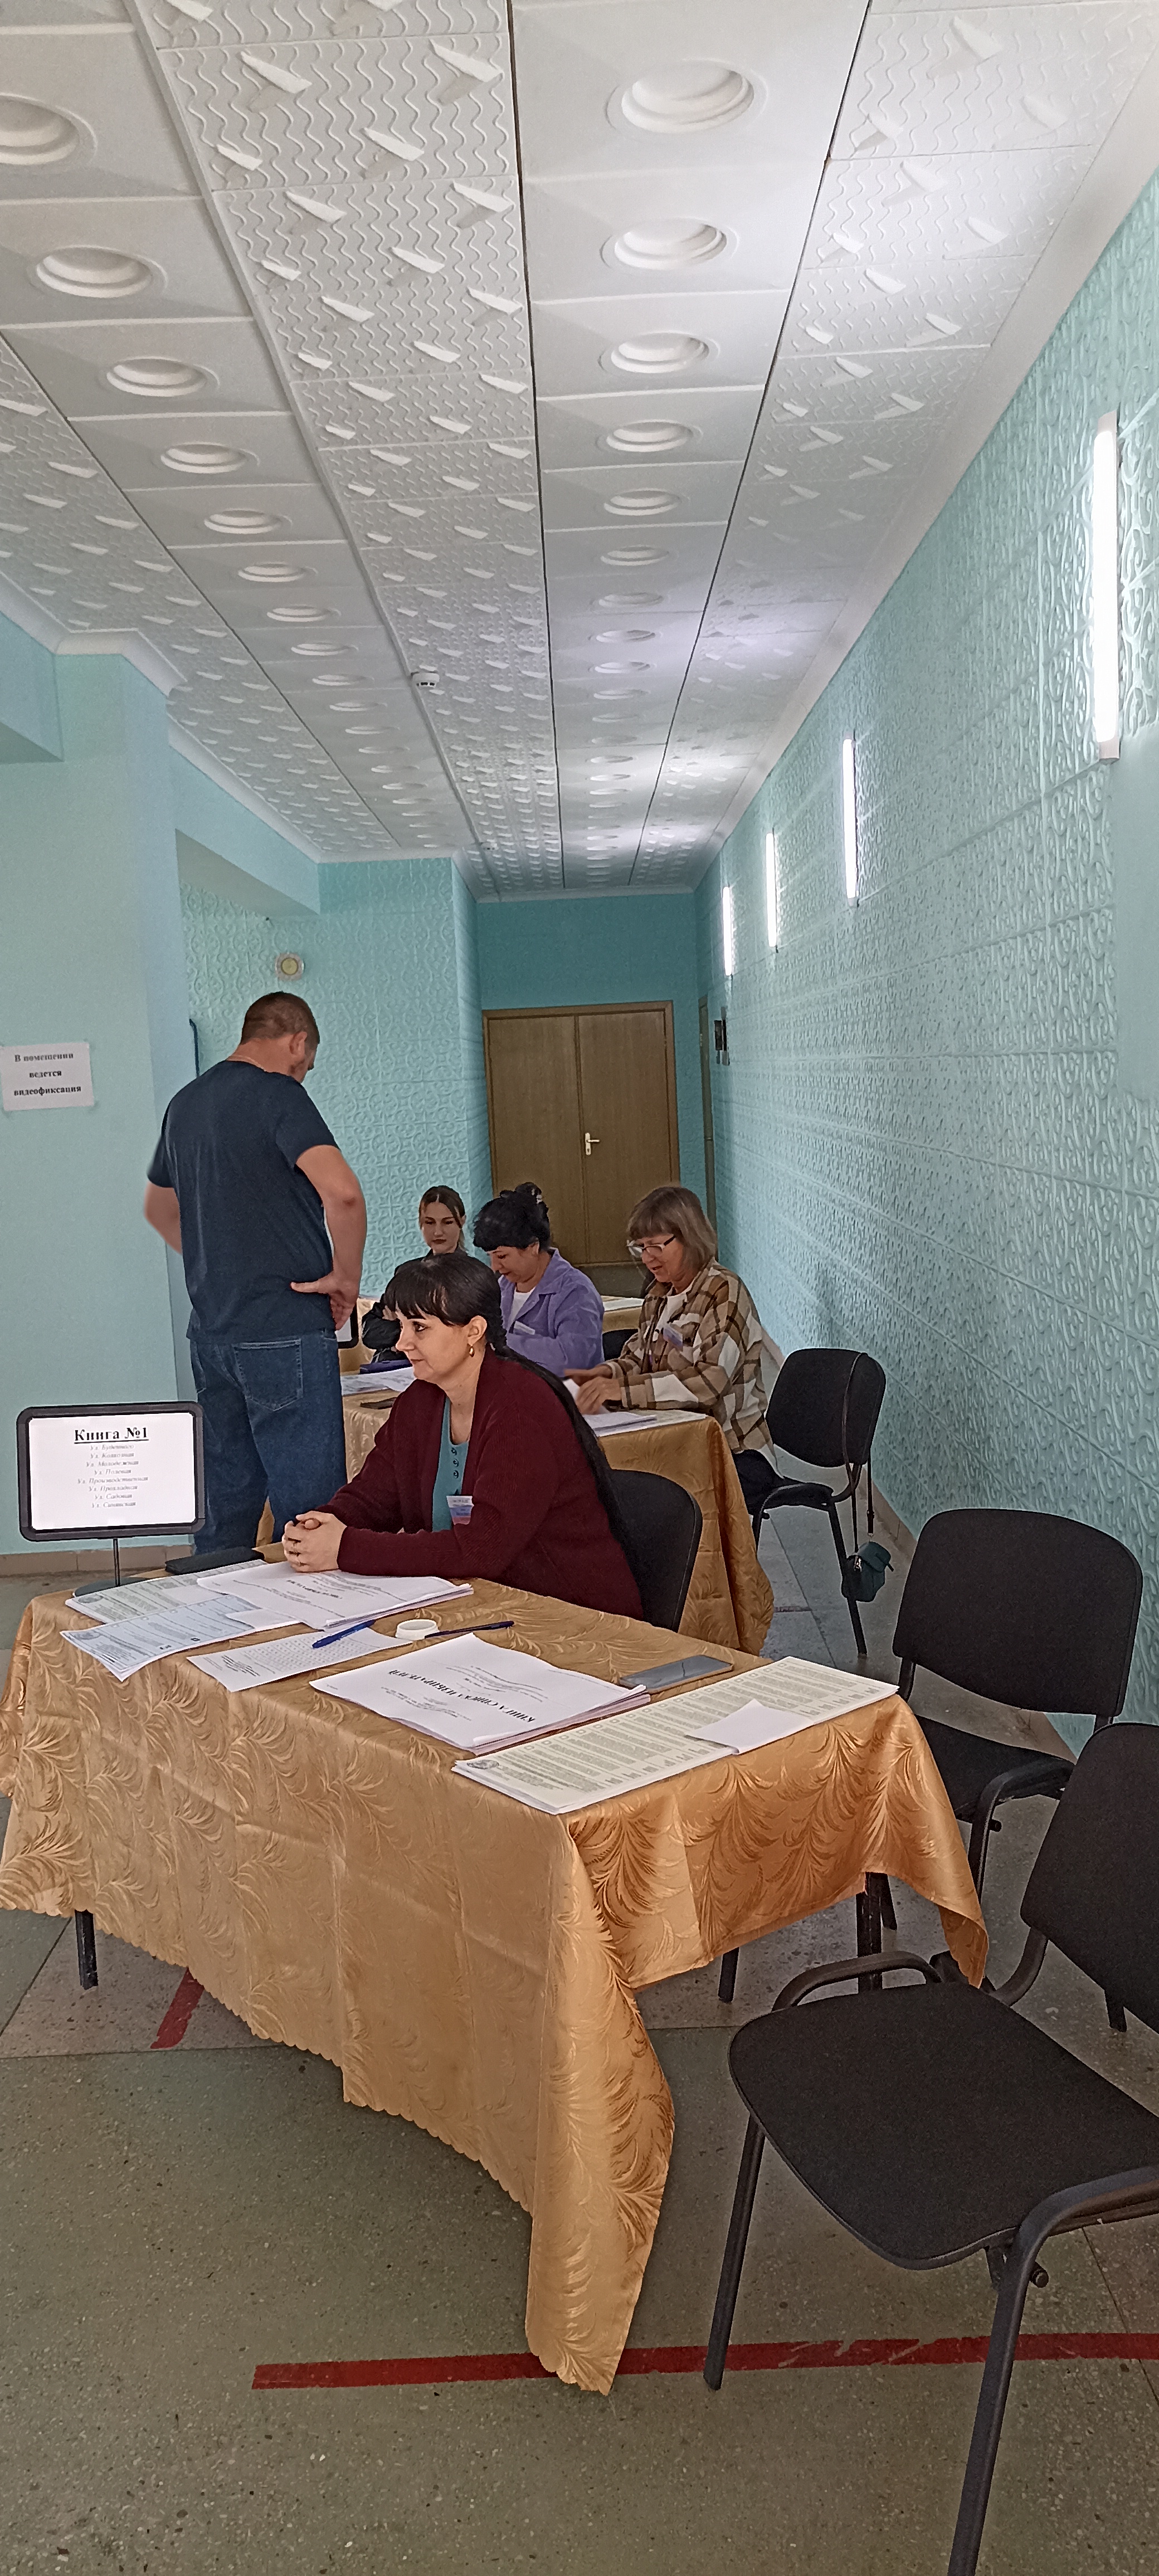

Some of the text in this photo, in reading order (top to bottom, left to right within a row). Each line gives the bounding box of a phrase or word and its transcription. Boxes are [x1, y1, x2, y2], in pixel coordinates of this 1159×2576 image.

[23, 1052, 74, 1062] помещении
[14, 1086, 81, 1096] видеофиксация
[75, 1427, 148, 1441] Книга №1
